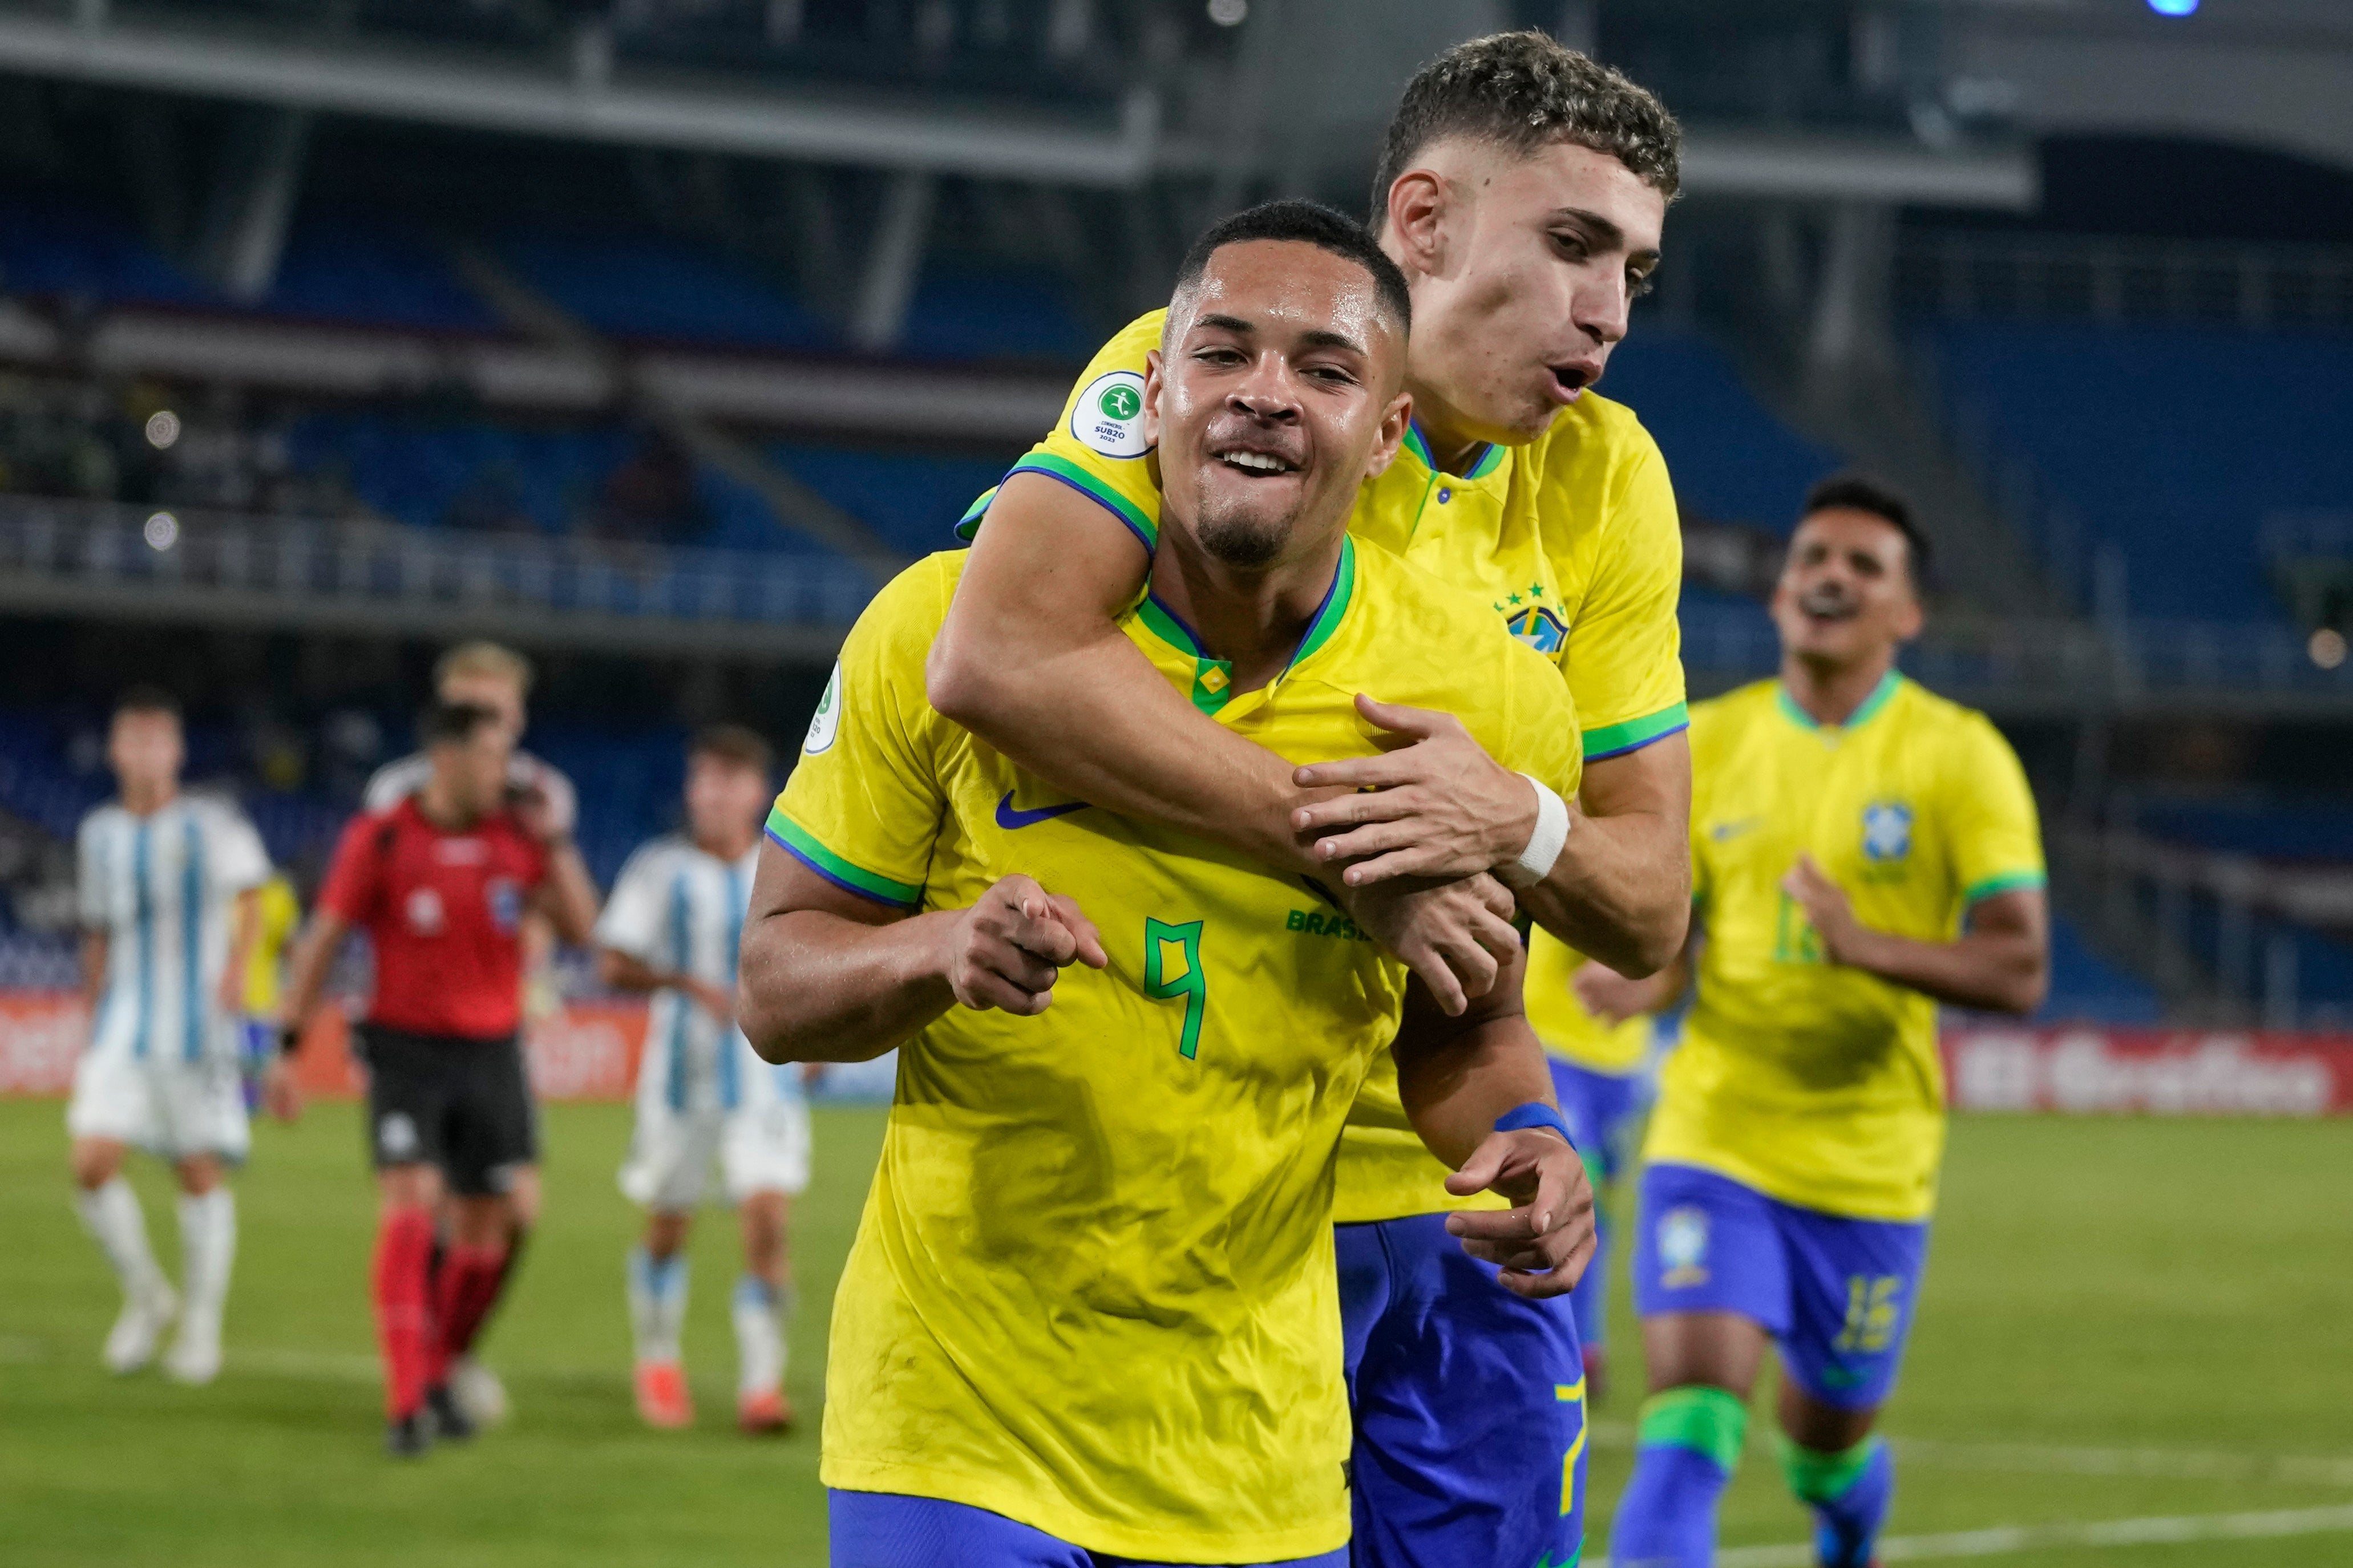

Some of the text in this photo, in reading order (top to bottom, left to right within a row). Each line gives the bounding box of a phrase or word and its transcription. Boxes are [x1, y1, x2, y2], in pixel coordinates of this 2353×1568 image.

[1094, 426, 1125, 439] SUB20
[1143, 915, 1206, 1061] 9
[1553, 1372, 1587, 1518] 7
